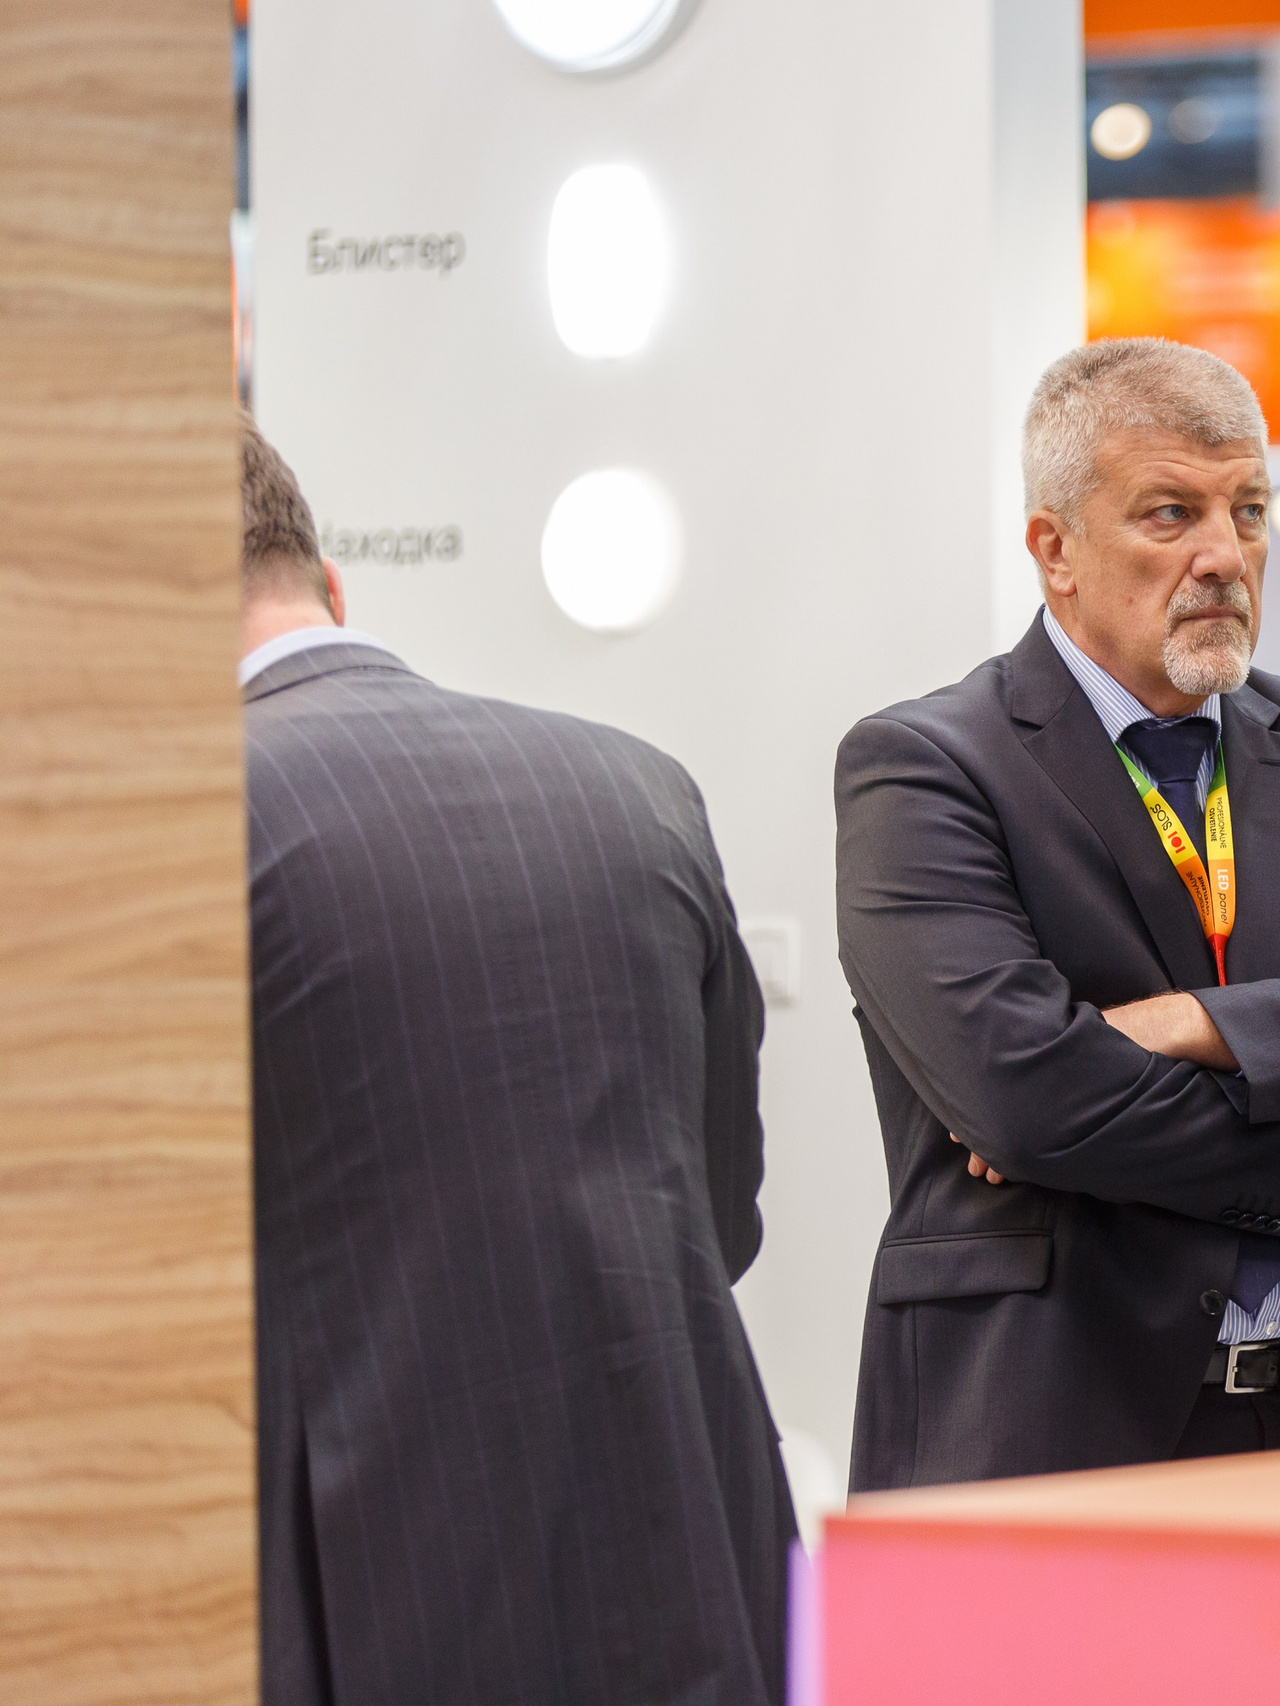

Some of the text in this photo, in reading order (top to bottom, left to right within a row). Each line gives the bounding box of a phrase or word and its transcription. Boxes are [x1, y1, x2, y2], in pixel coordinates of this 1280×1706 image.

[307, 228, 467, 279] Блистер
[1209, 807, 1218, 842] OSVETLENIE
[1217, 868, 1229, 925] LED panel
